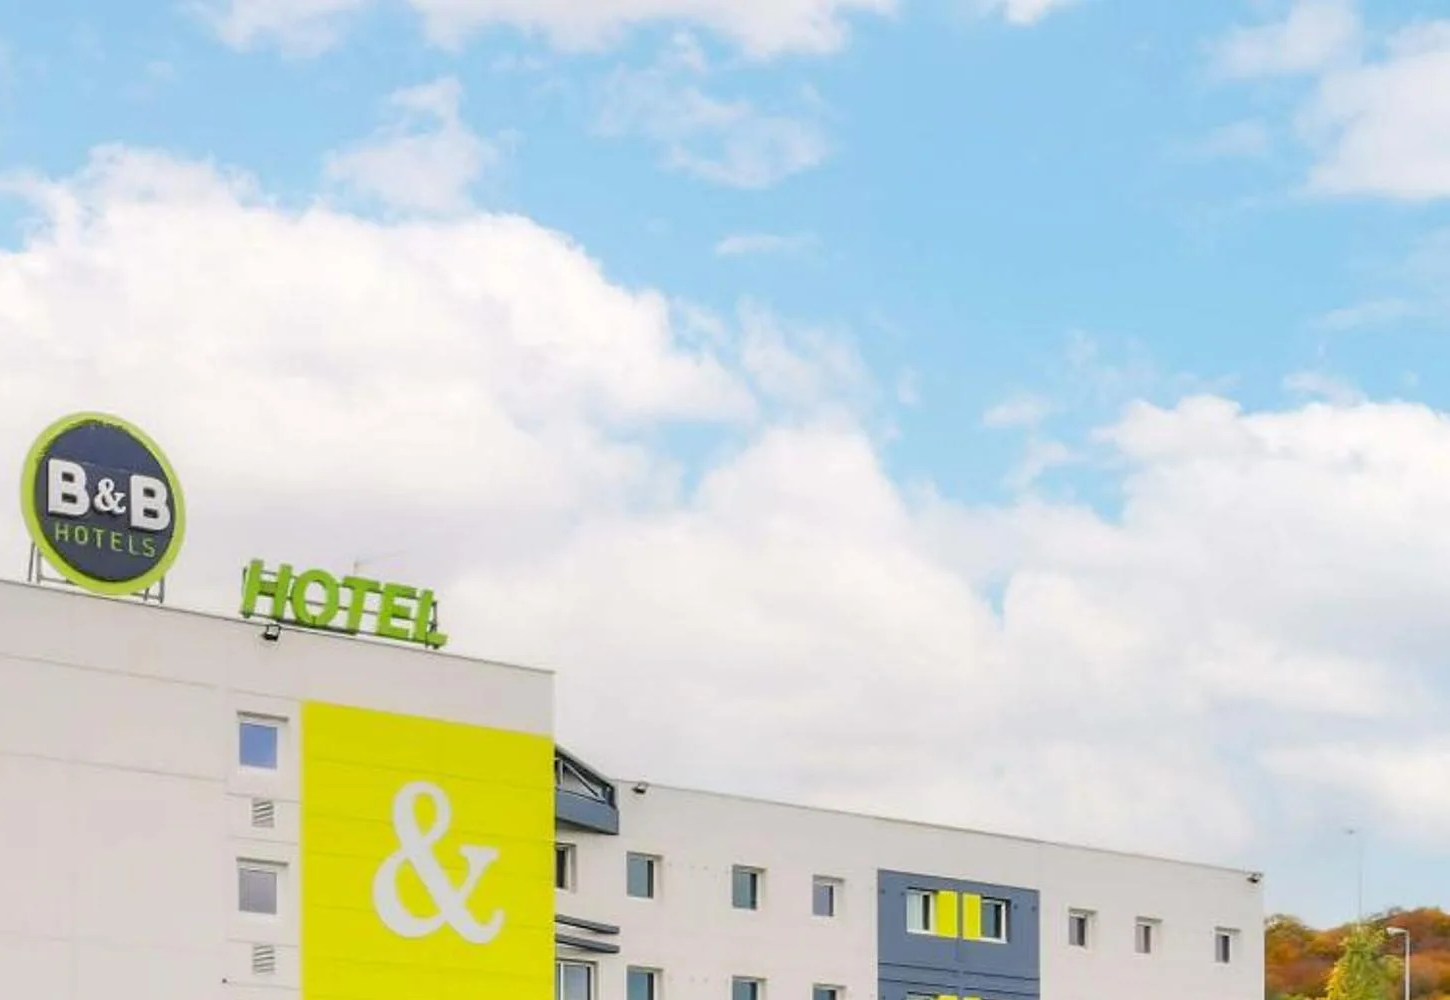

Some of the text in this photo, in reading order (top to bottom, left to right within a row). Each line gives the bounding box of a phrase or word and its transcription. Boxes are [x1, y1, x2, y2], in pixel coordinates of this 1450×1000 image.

[47, 458, 171, 531] B&B
[54, 521, 156, 558] HOTELS
[240, 558, 448, 648] HOTEL
